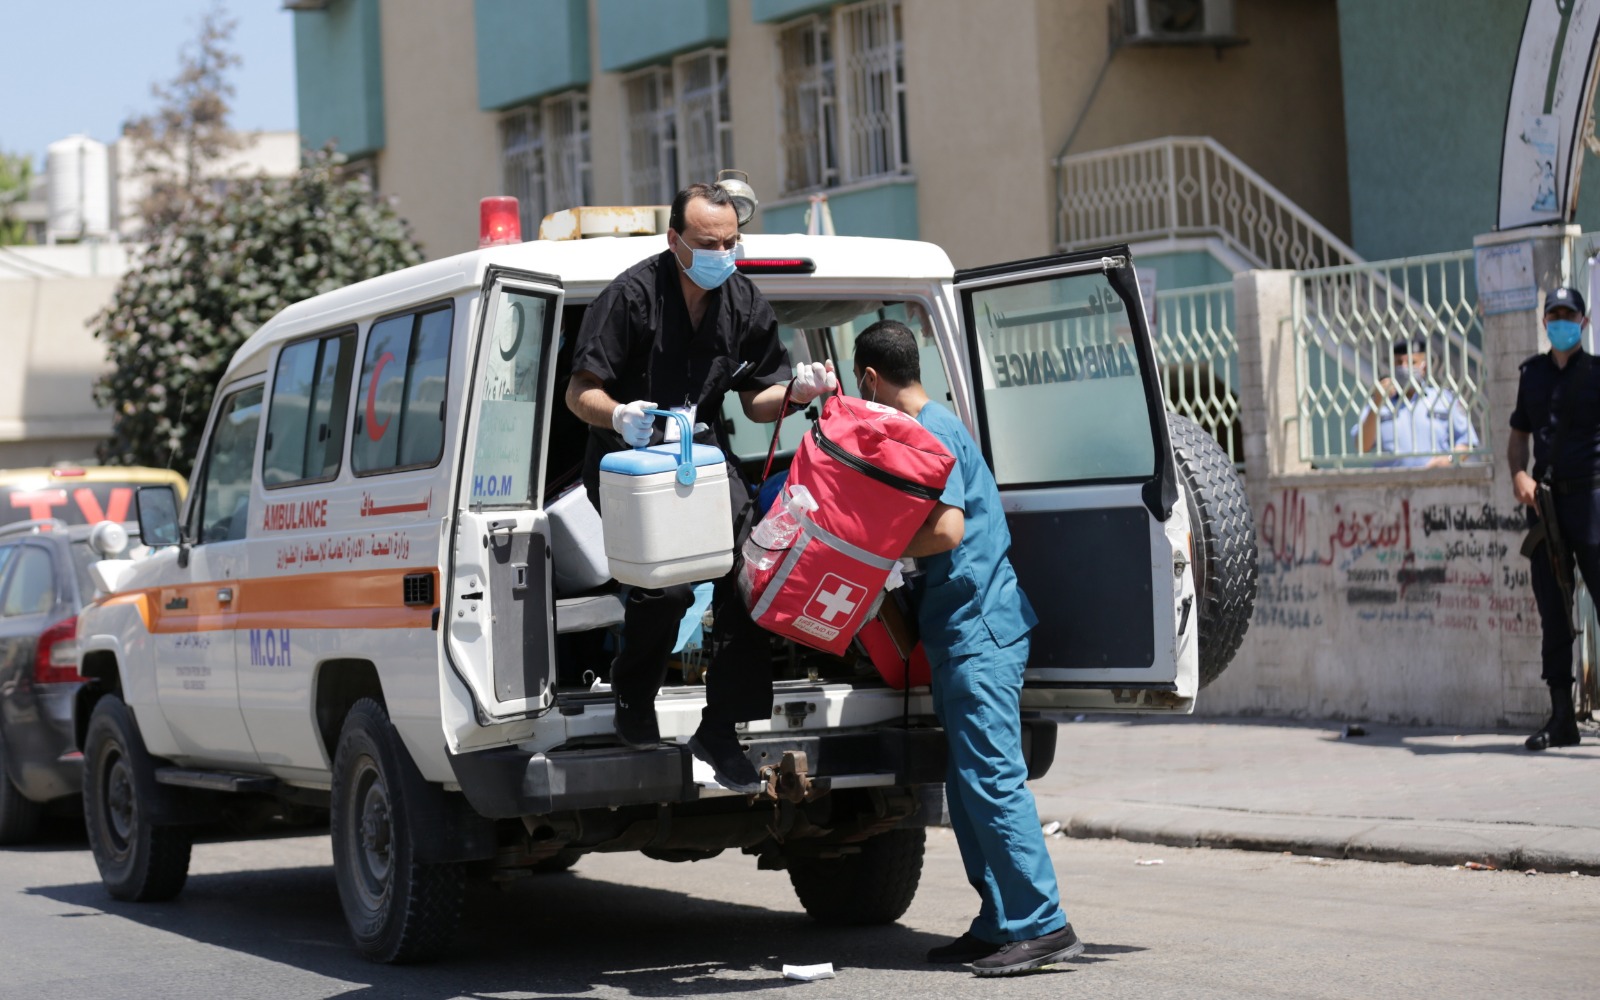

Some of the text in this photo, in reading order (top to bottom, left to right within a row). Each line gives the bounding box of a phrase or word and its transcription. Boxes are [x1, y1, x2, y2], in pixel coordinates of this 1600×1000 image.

[10, 488, 133, 532] TV
[263, 500, 328, 531] AMBULANCE
[1261, 487, 1306, 566] الله
[371, 533, 393, 556] الصحة
[393, 531, 410, 560] وزارة
[798, 618, 815, 627] FIRST
[825, 629, 837, 637] KIT
[250, 629, 291, 667] M.O.H
